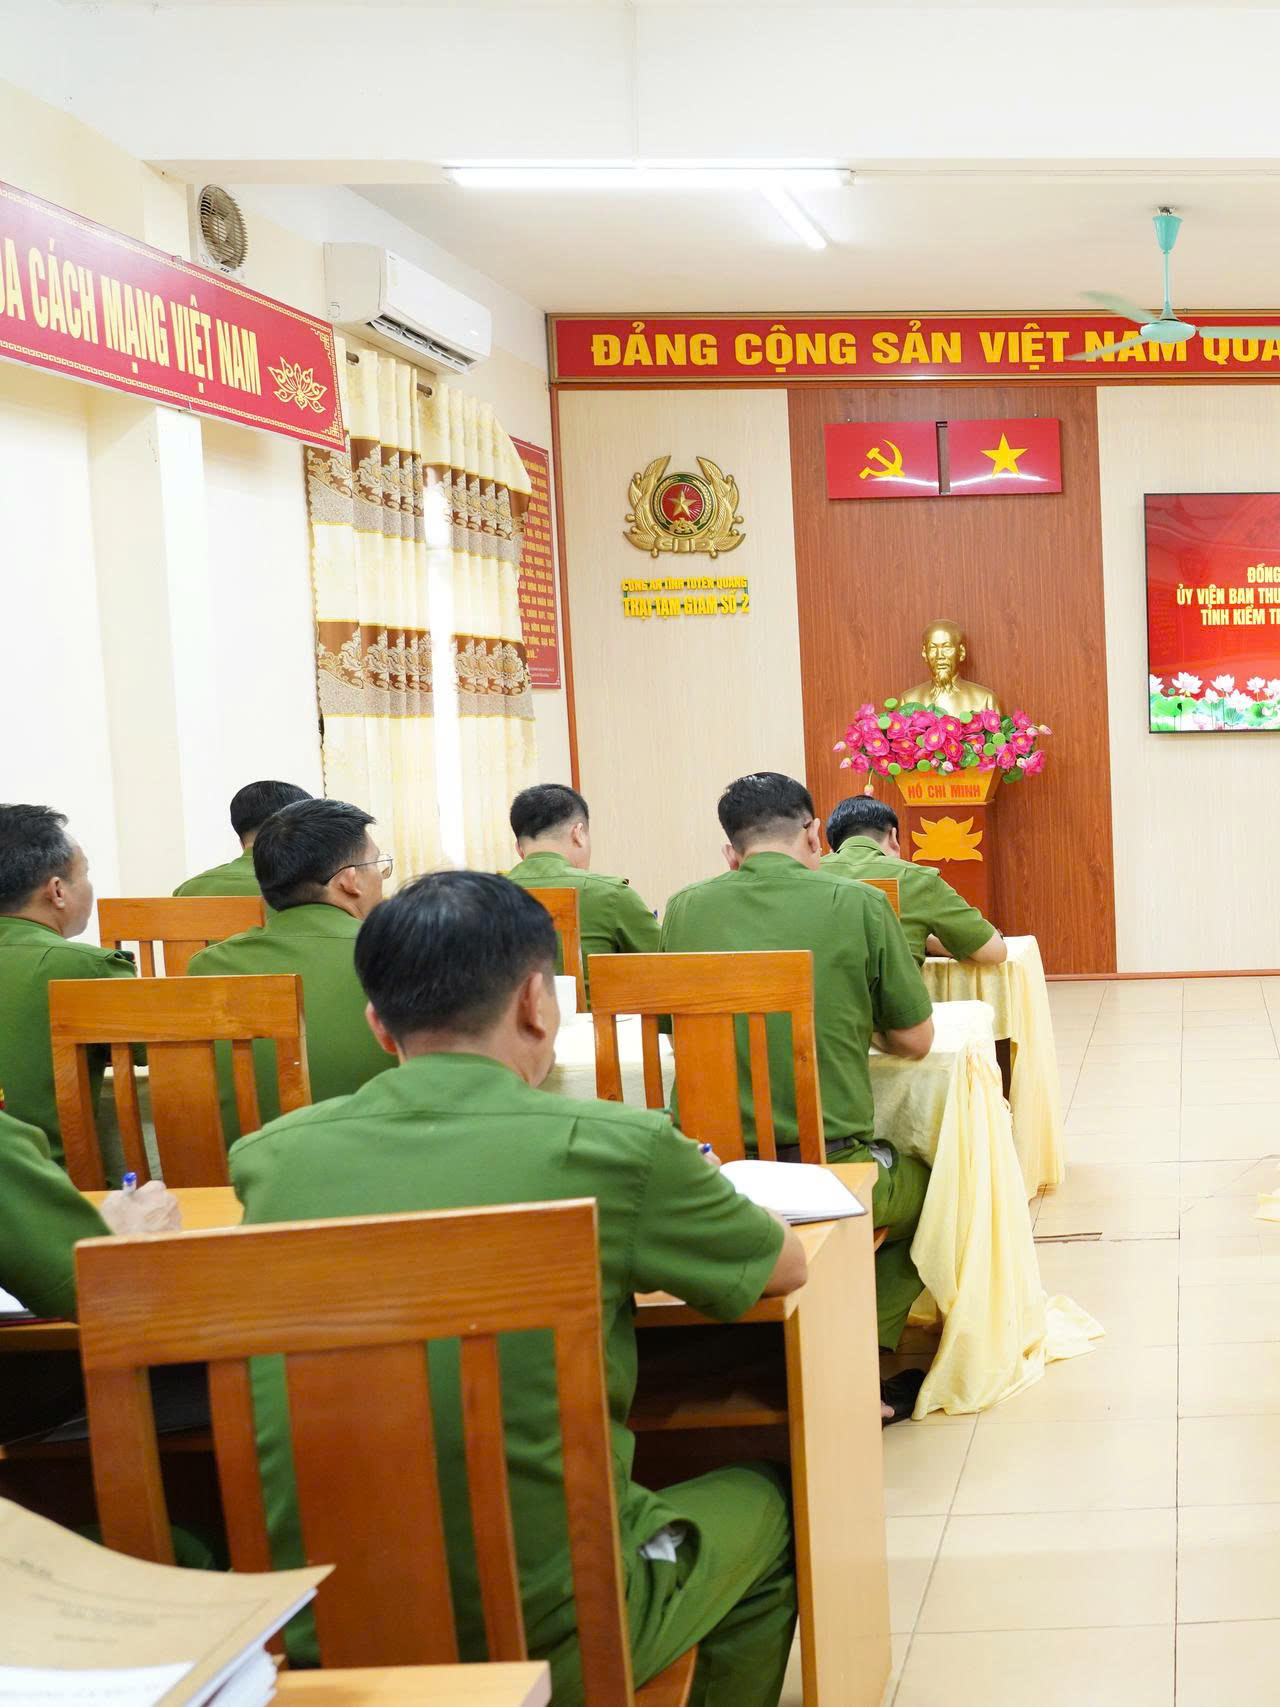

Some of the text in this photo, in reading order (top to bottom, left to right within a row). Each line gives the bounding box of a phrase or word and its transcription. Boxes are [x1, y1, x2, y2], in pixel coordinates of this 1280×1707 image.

[28, 237, 99, 344] CÁCH
[100, 274, 170, 374] MẠNG
[169, 293, 214, 393] VIỆT
[215, 318, 262, 396] NAM
[591, 321, 718, 366] ĐẢNG
[734, 324, 857, 373] CỘNG
[872, 320, 963, 364] SẢN
[979, 322, 1070, 370] VIỆT
[1085, 330, 1187, 362] NAM
[623, 588, 750, 620] TRẠI TẠM GIAM SỐ 2
[1176, 583, 1194, 605] ỦY
[1229, 588, 1254, 604] BAN
[1233, 604, 1266, 625] KIỂM
[950, 783, 982, 798] MINH
